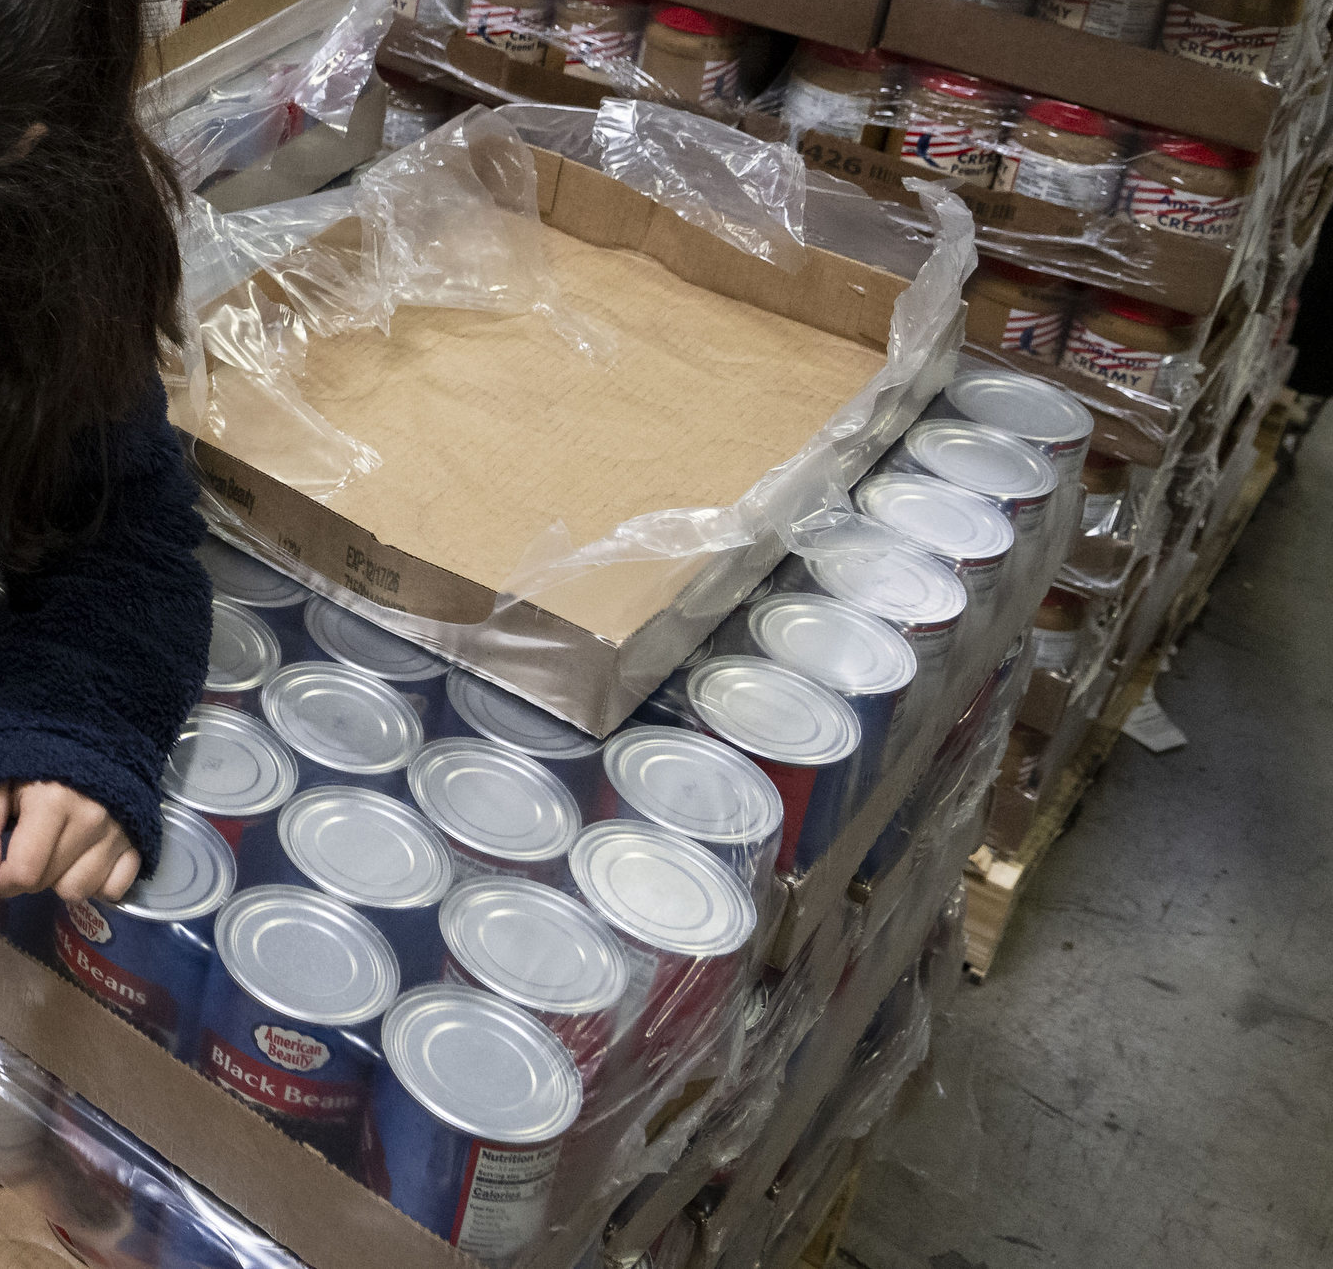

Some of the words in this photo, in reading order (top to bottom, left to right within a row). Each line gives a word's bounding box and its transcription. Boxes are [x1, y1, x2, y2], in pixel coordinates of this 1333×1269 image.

[1177, 38, 1260, 66] CREAMY
[1158, 194, 1241, 219] American
[76, 948, 147, 1006] Beans
[263, 1027, 323, 1056] American
[267, 1043, 314, 1069] Beauty
[211, 1044, 277, 1097] Black
[481, 1149, 534, 1164] Nutrition
[472, 1187, 521, 1200] Calories
